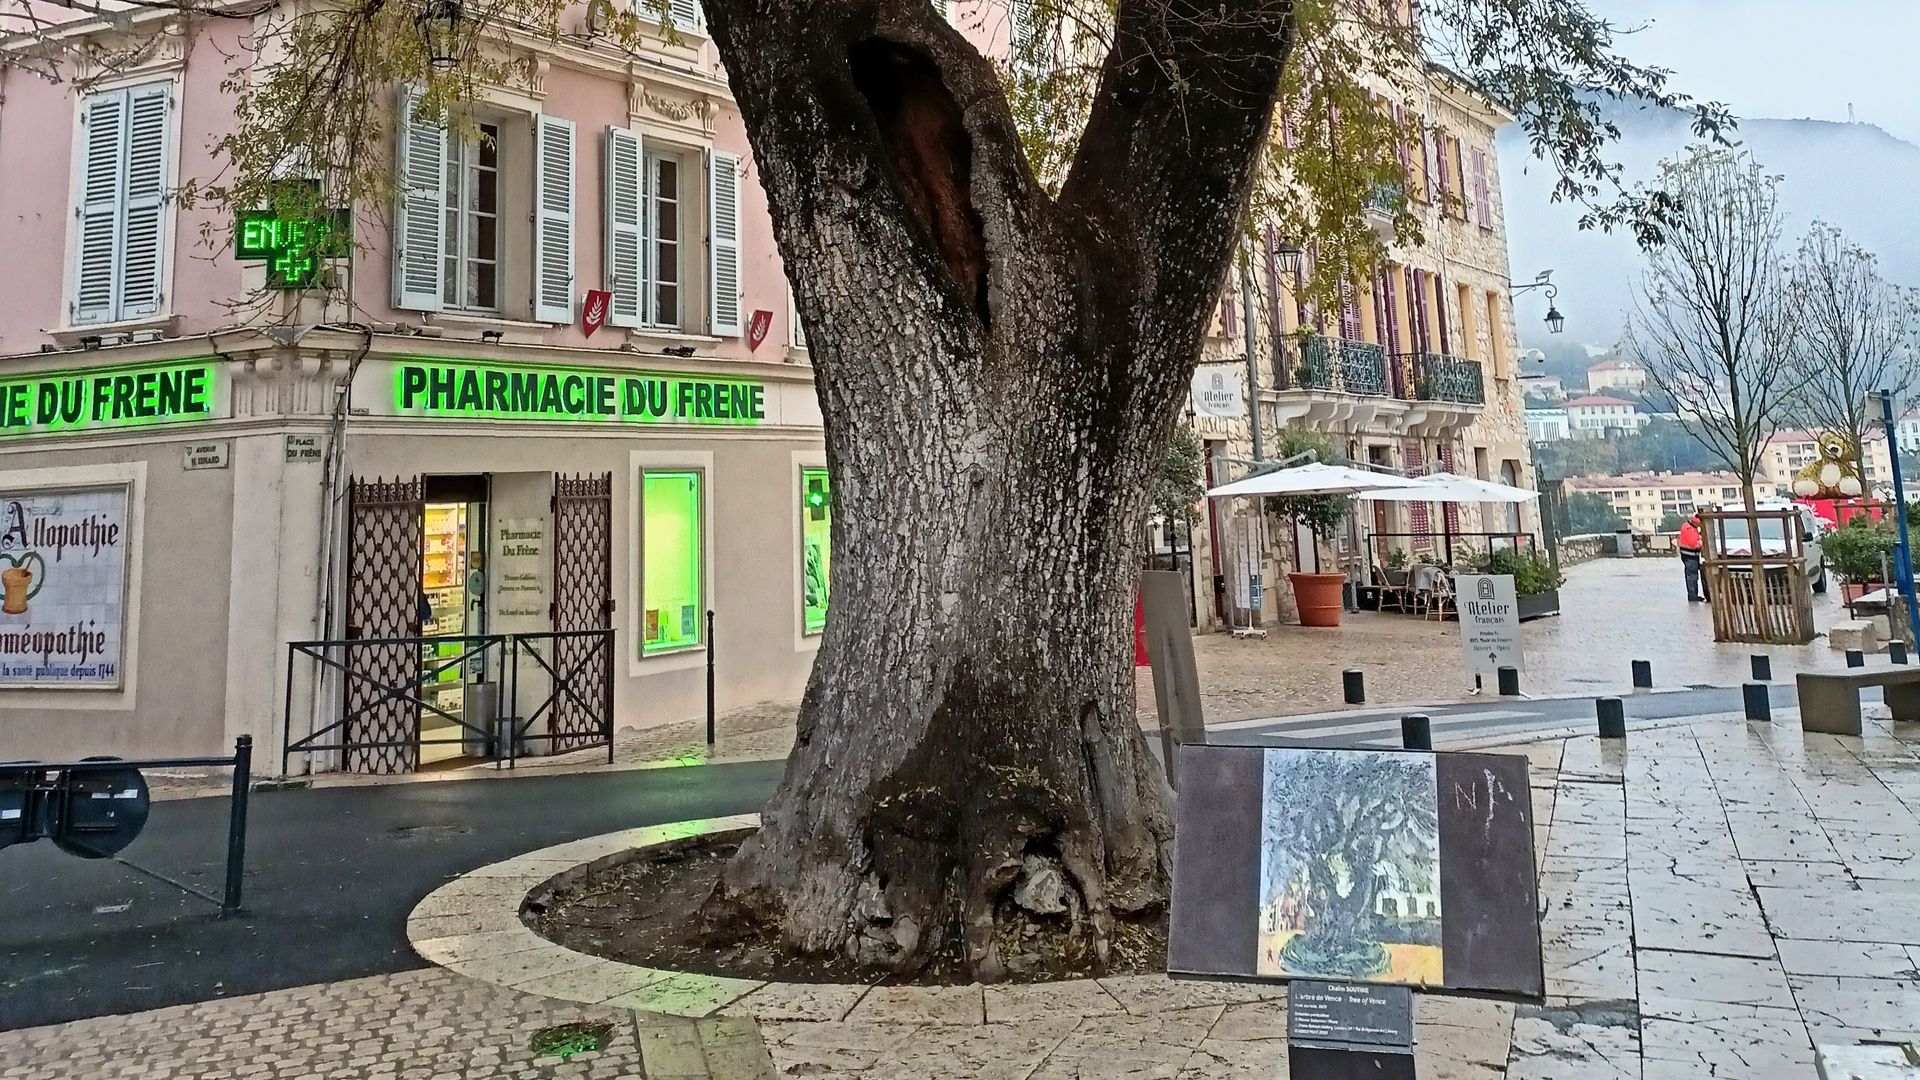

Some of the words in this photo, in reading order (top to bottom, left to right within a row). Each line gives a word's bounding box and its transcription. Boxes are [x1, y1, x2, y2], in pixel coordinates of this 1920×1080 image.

[37, 379, 84, 425] DU
[92, 368, 207, 421] FRENE
[402, 366, 616, 415] PHARMACIE
[624, 378, 668, 417] DU
[677, 382, 765, 419] FRENE
[196, 445, 216, 453] AVENUE
[287, 449, 298, 457] DU
[300, 447, 321, 457] FRÊNE
[2, 501, 119, 563] Allopathie
[500, 529, 542, 540] Pharmacie
[502, 545, 515, 556] Du
[1475, 615, 1504, 624] français
[0, 619, 106, 667] méopathie
[2, 662, 10, 676] la
[35, 662, 69, 680] publique
[70, 663, 96, 680] depuis
[98, 663, 115, 680] 1744
[1361, 997, 1369, 1005] of
[1369, 997, 1386, 1005] Vence
